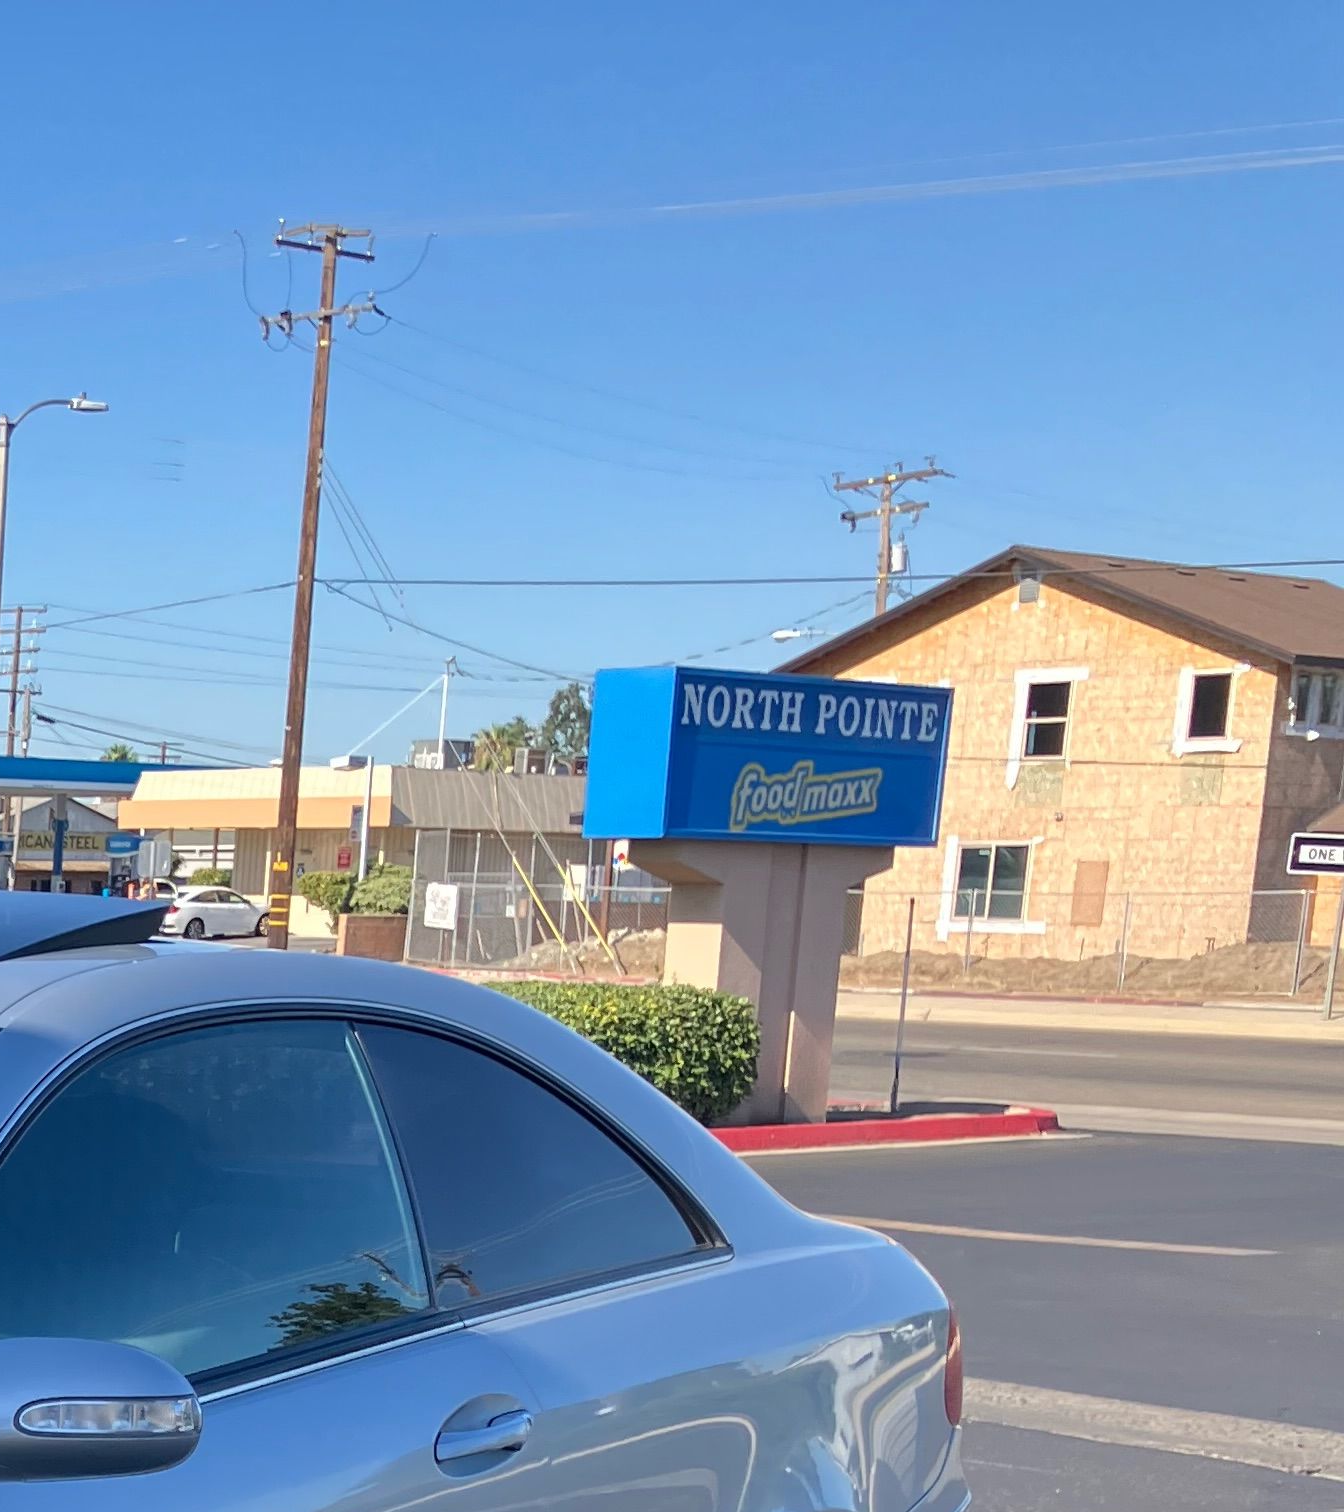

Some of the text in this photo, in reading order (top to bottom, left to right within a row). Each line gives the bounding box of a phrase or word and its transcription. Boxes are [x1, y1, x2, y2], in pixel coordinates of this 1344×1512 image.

[680, 683, 939, 743] NORTH POINTE
[1308, 848, 1337, 862] ONE
